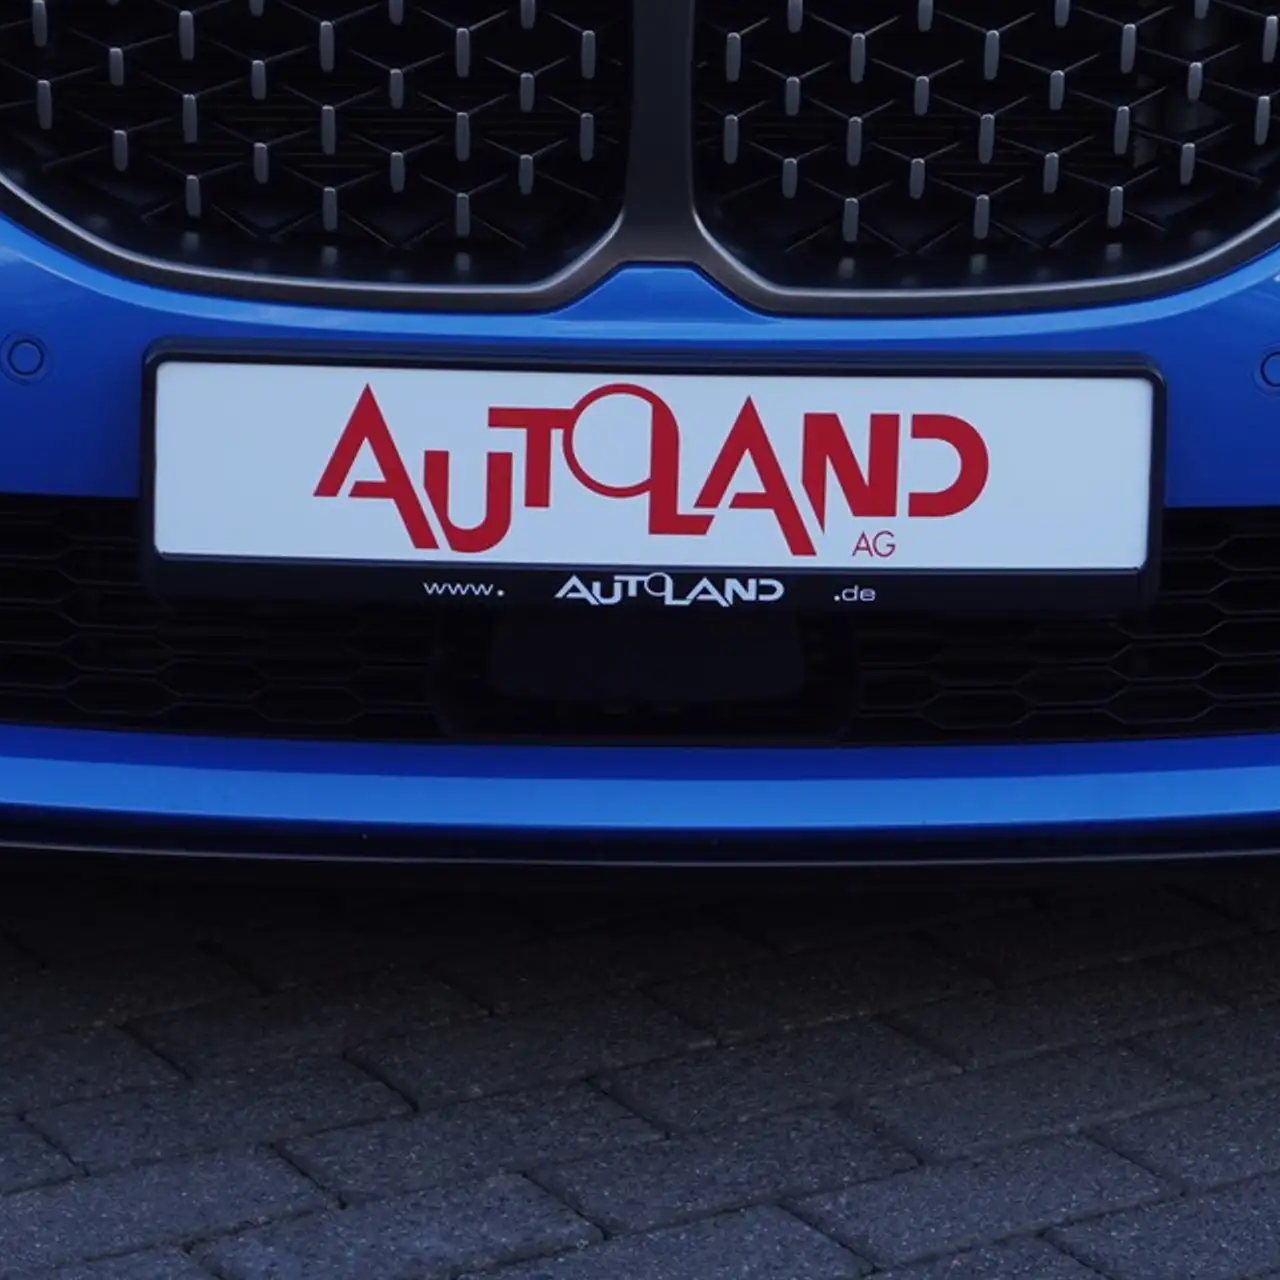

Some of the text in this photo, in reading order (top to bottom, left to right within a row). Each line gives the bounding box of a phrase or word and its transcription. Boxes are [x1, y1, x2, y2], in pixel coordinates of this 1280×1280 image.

[313, 383, 989, 556] AUTOLAND
[852, 531, 896, 559] AG
[423, 571, 877, 608] www. AUTOLAND .de
